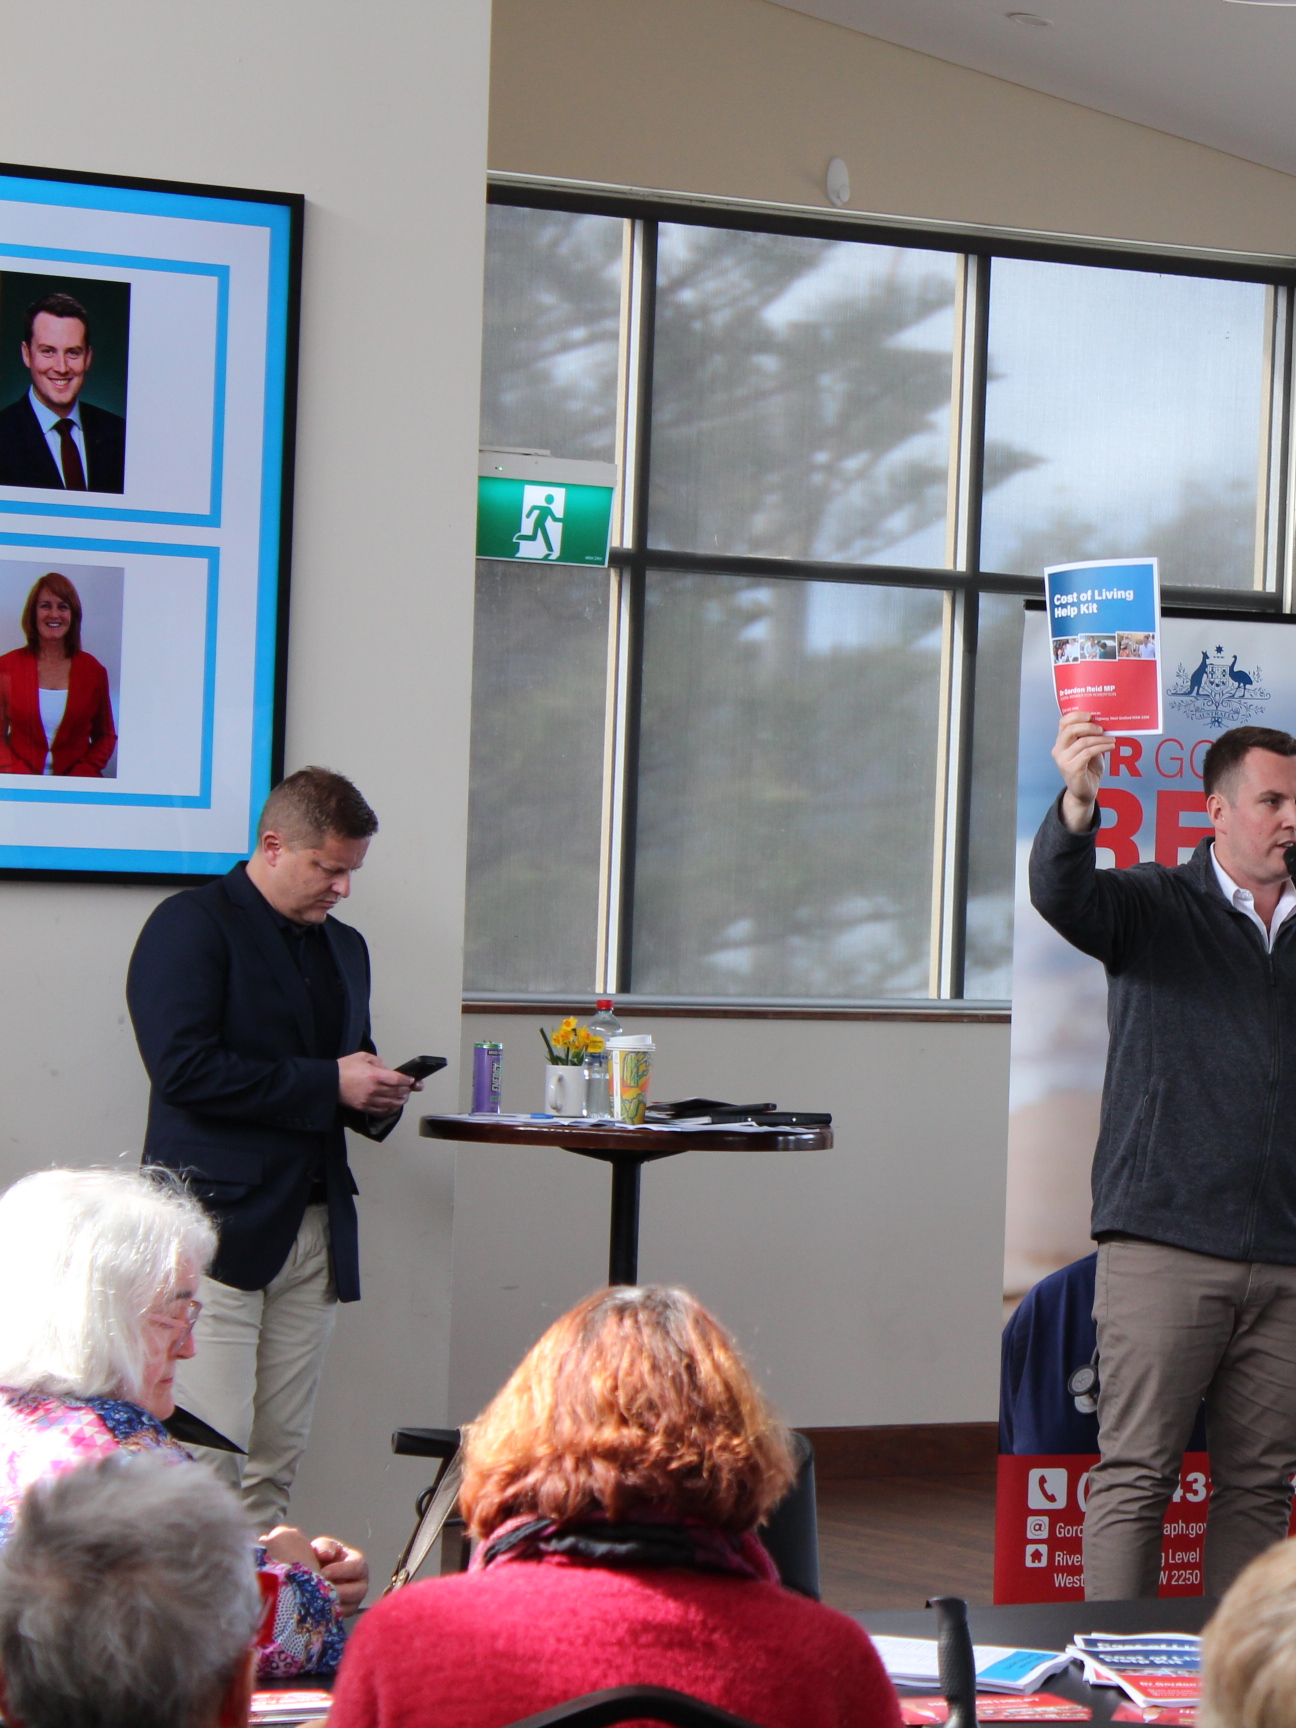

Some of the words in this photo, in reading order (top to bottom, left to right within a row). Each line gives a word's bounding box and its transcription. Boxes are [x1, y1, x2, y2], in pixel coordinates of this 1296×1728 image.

[1054, 592, 1078, 605] Cost
[1079, 589, 1092, 601] of
[1094, 588, 1134, 601] Living
[1054, 605, 1078, 618] Help
[1080, 602, 1098, 614] Kit
[1169, 1548, 1200, 1564] Level
[1054, 1573, 1085, 1588] West
[1171, 1571, 1200, 1585] 2250
